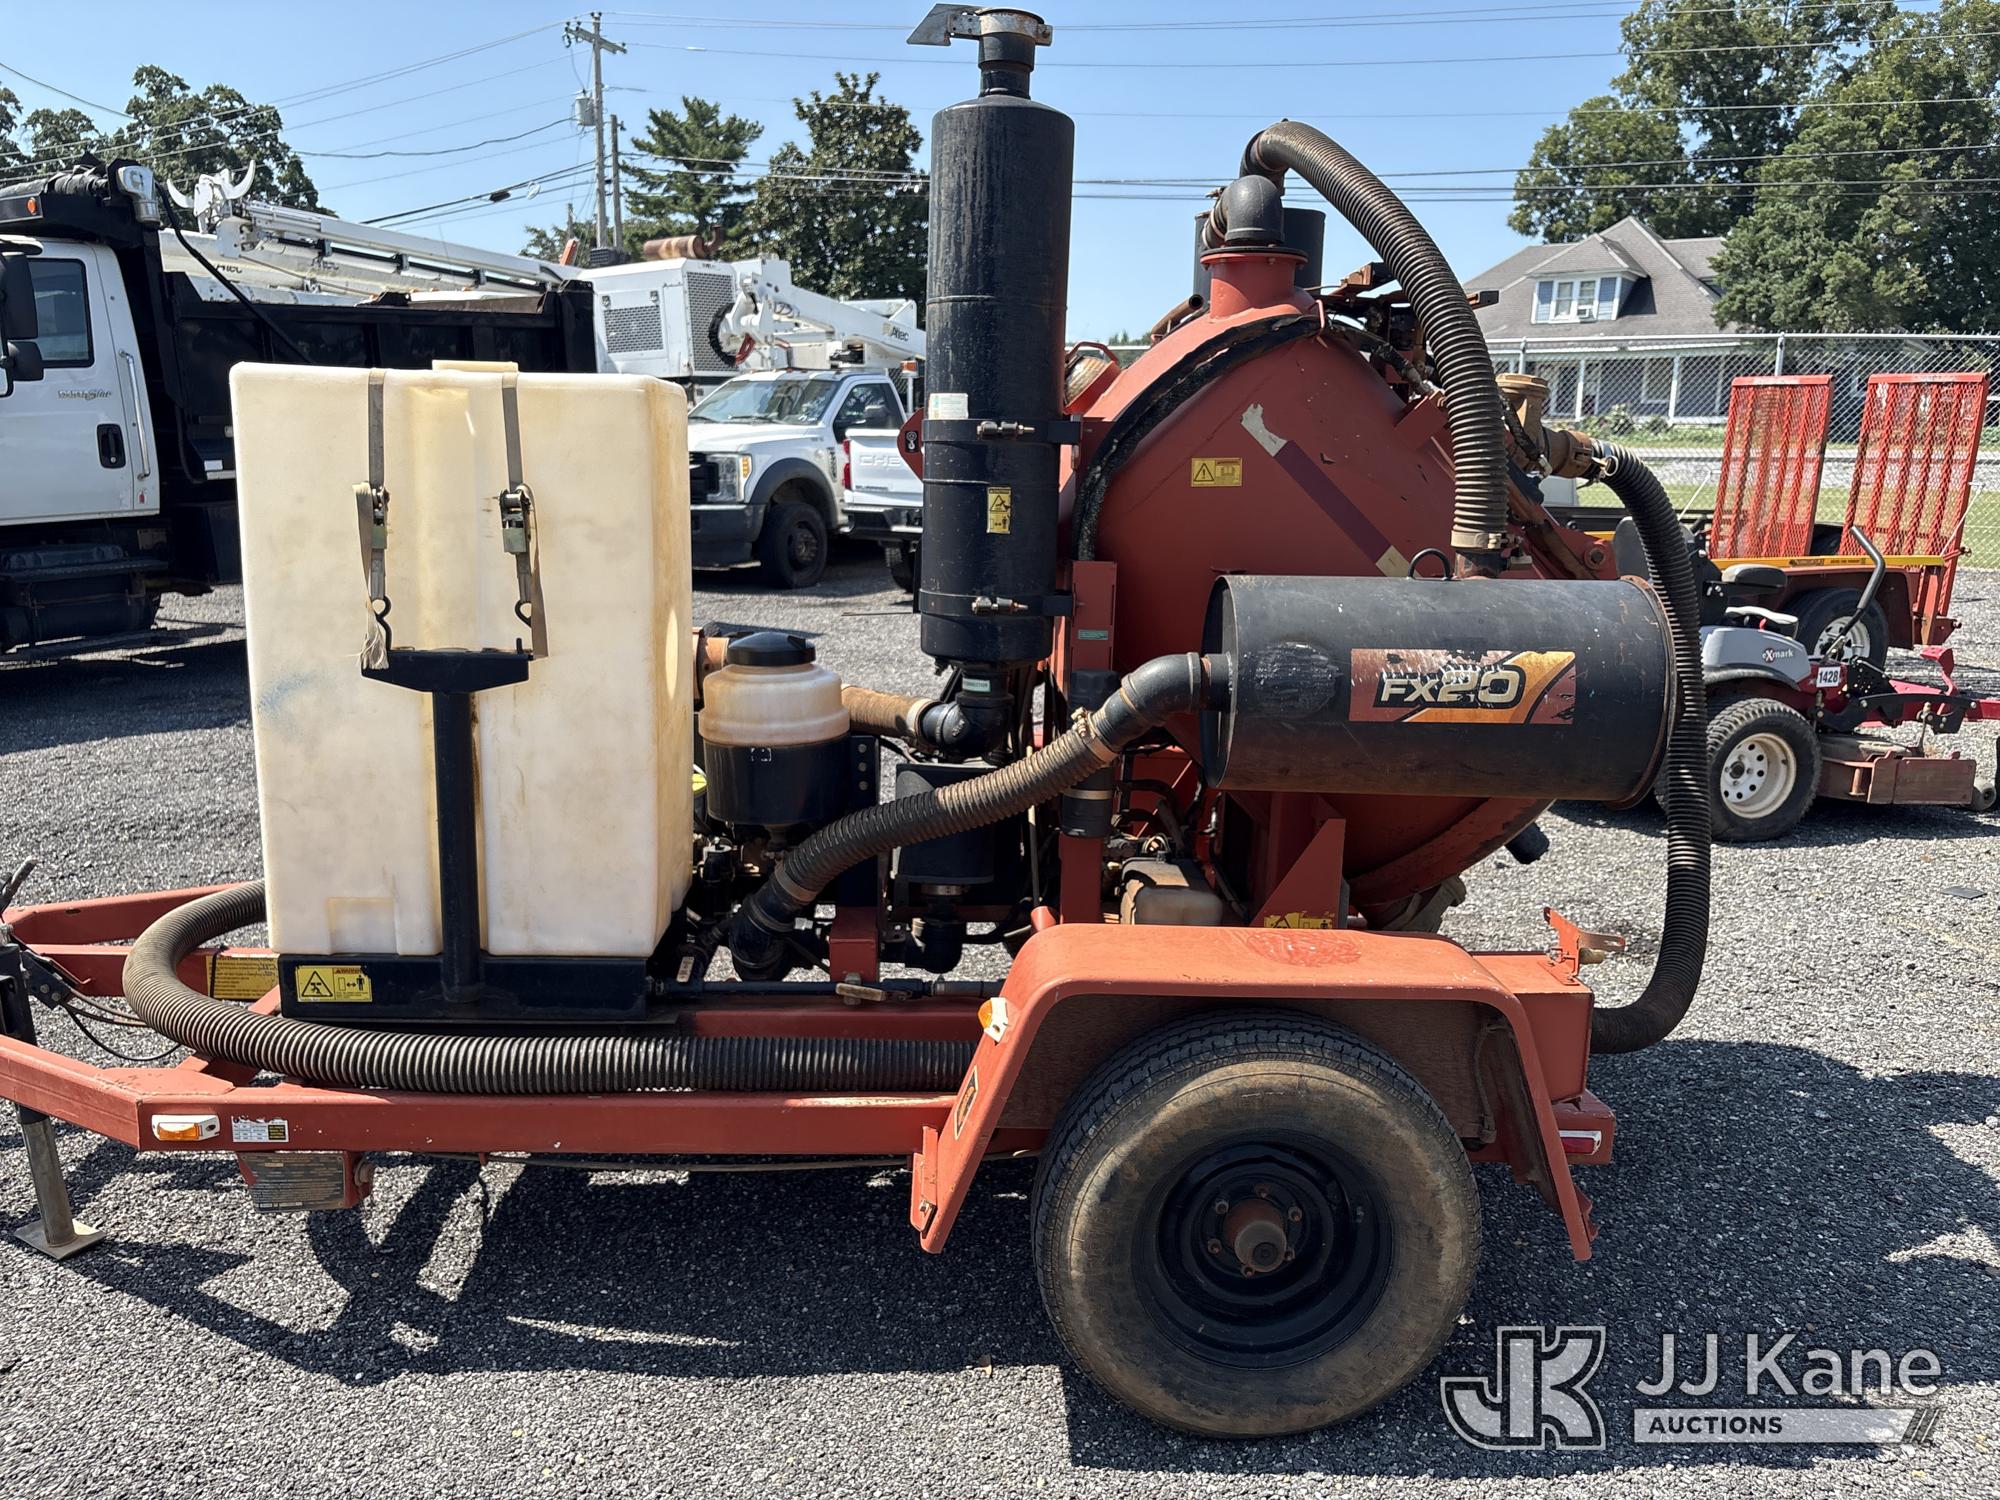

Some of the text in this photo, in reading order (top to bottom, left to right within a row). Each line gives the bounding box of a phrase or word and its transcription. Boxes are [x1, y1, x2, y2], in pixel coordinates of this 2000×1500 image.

[892, 326, 909, 341] Altec
[1819, 671, 1839, 684] 1428
[1380, 670, 1520, 703] FX20
